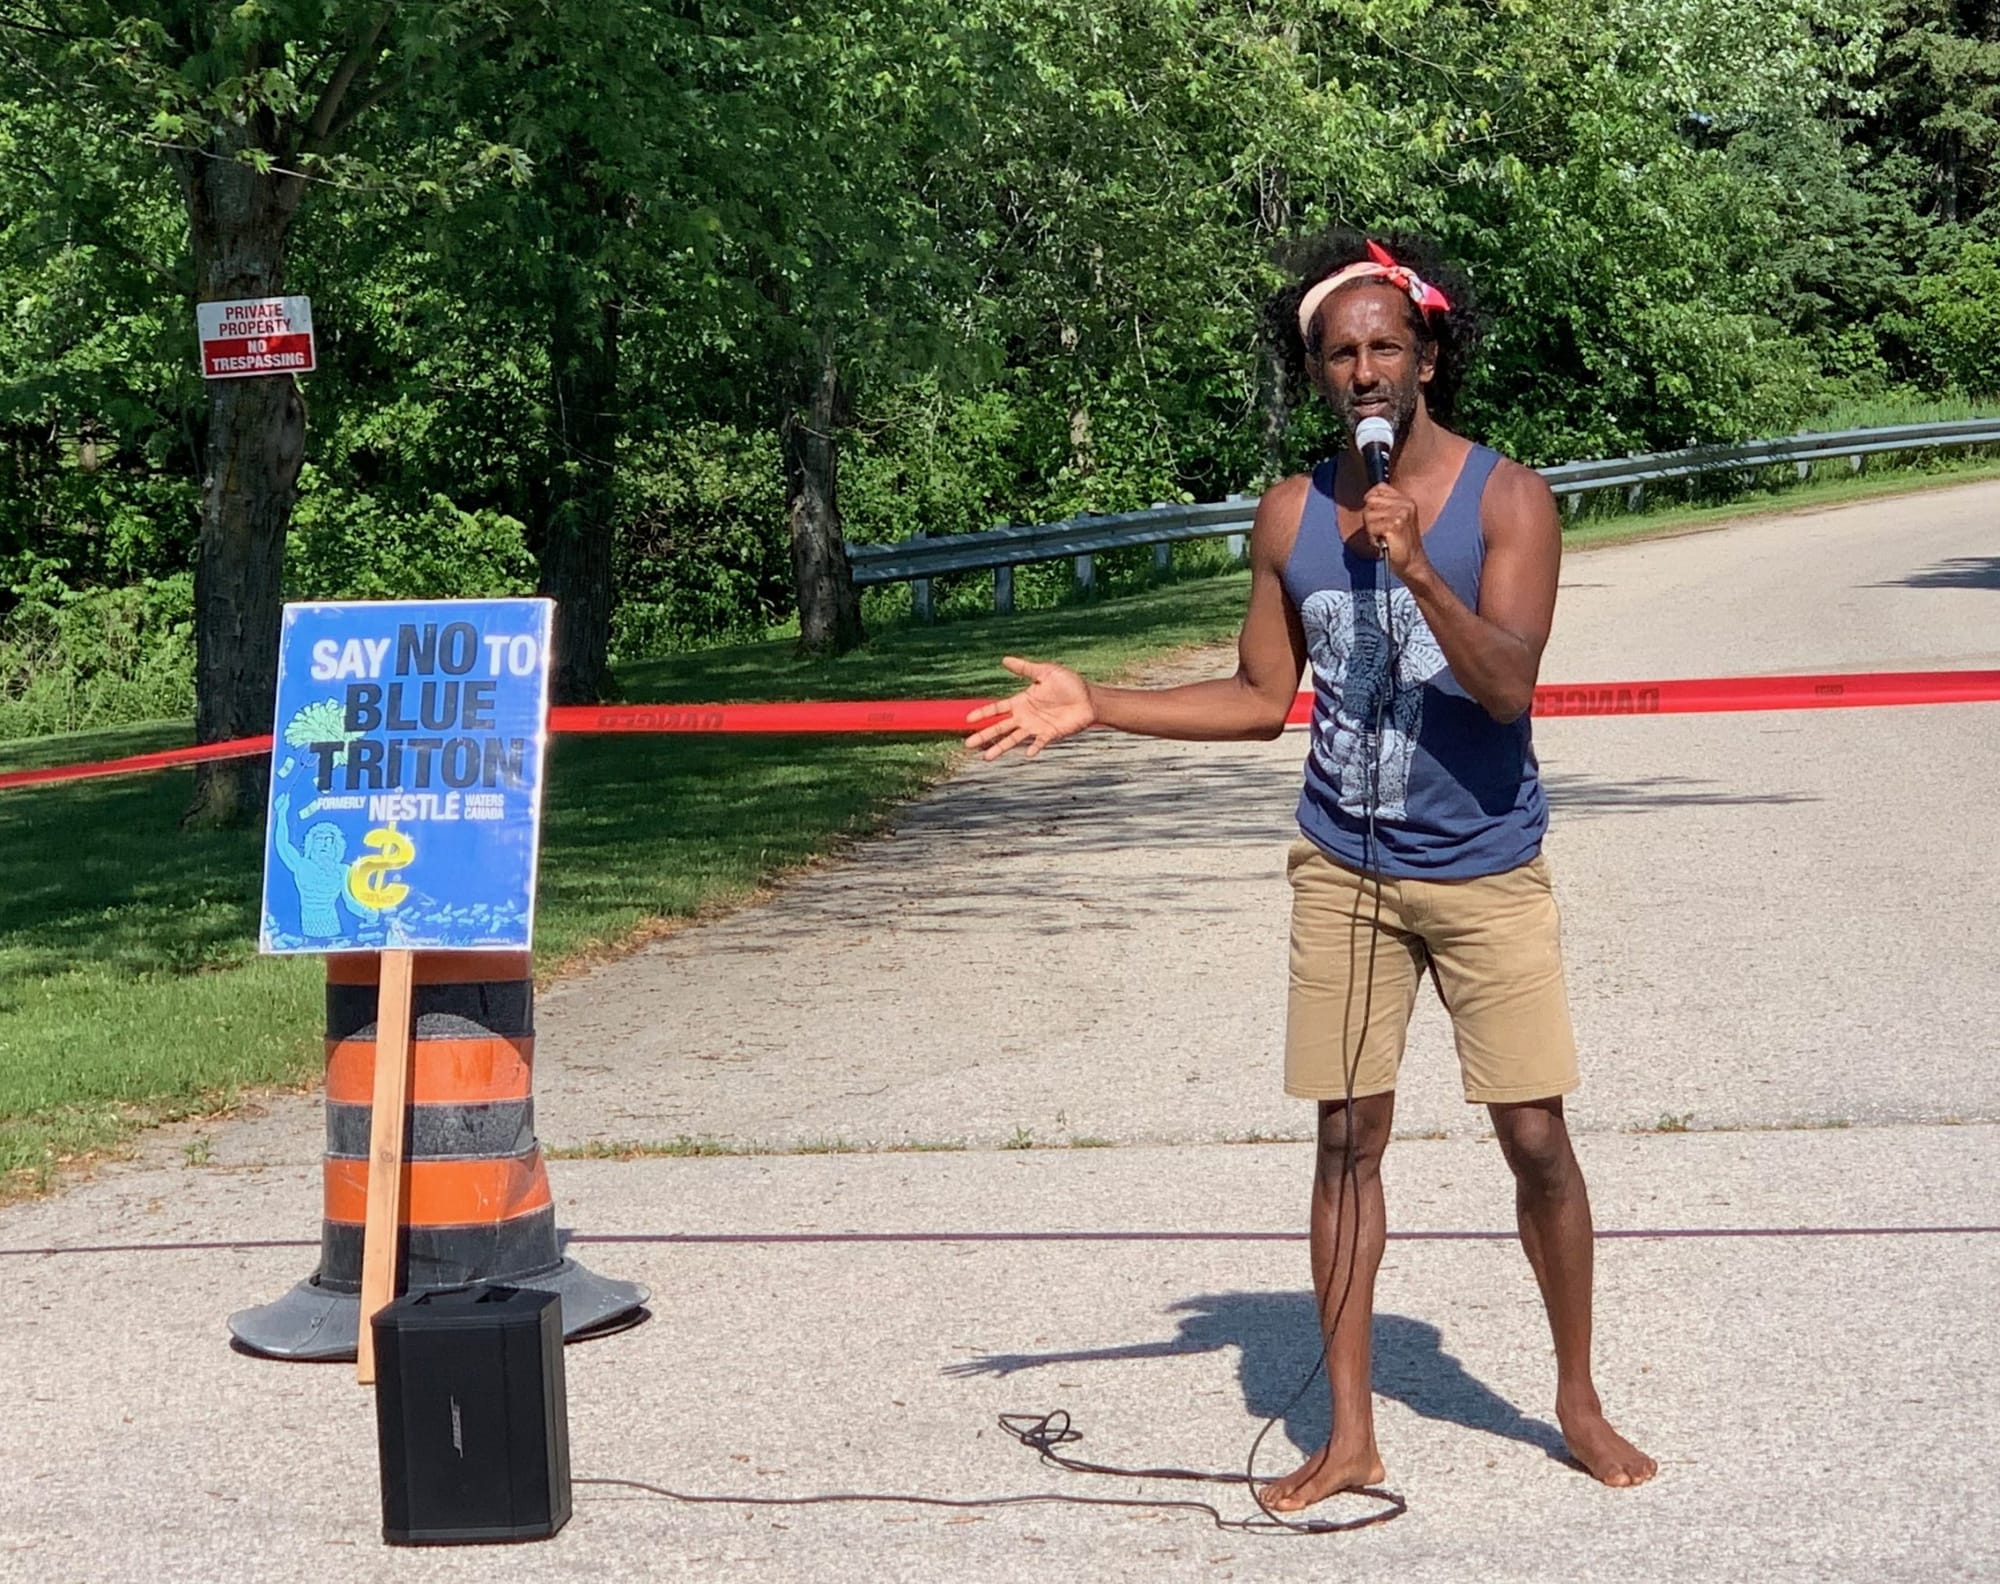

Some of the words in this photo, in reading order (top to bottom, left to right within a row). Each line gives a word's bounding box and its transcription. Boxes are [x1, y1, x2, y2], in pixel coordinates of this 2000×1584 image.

[226, 304, 282, 319] PRIVATE
[219, 319, 291, 336] PROPERTY
[248, 340, 267, 353] NO
[212, 352, 304, 371] TRESPASSING
[310, 637, 391, 680] SAY
[395, 621, 478, 677] NO
[483, 634, 538, 678] TO
[345, 681, 496, 731] BLUE
[310, 738, 524, 790] TRITON
[317, 795, 367, 811] FORMERLY
[464, 793, 505, 807] WATERS
[464, 807, 505, 820] CANADA
